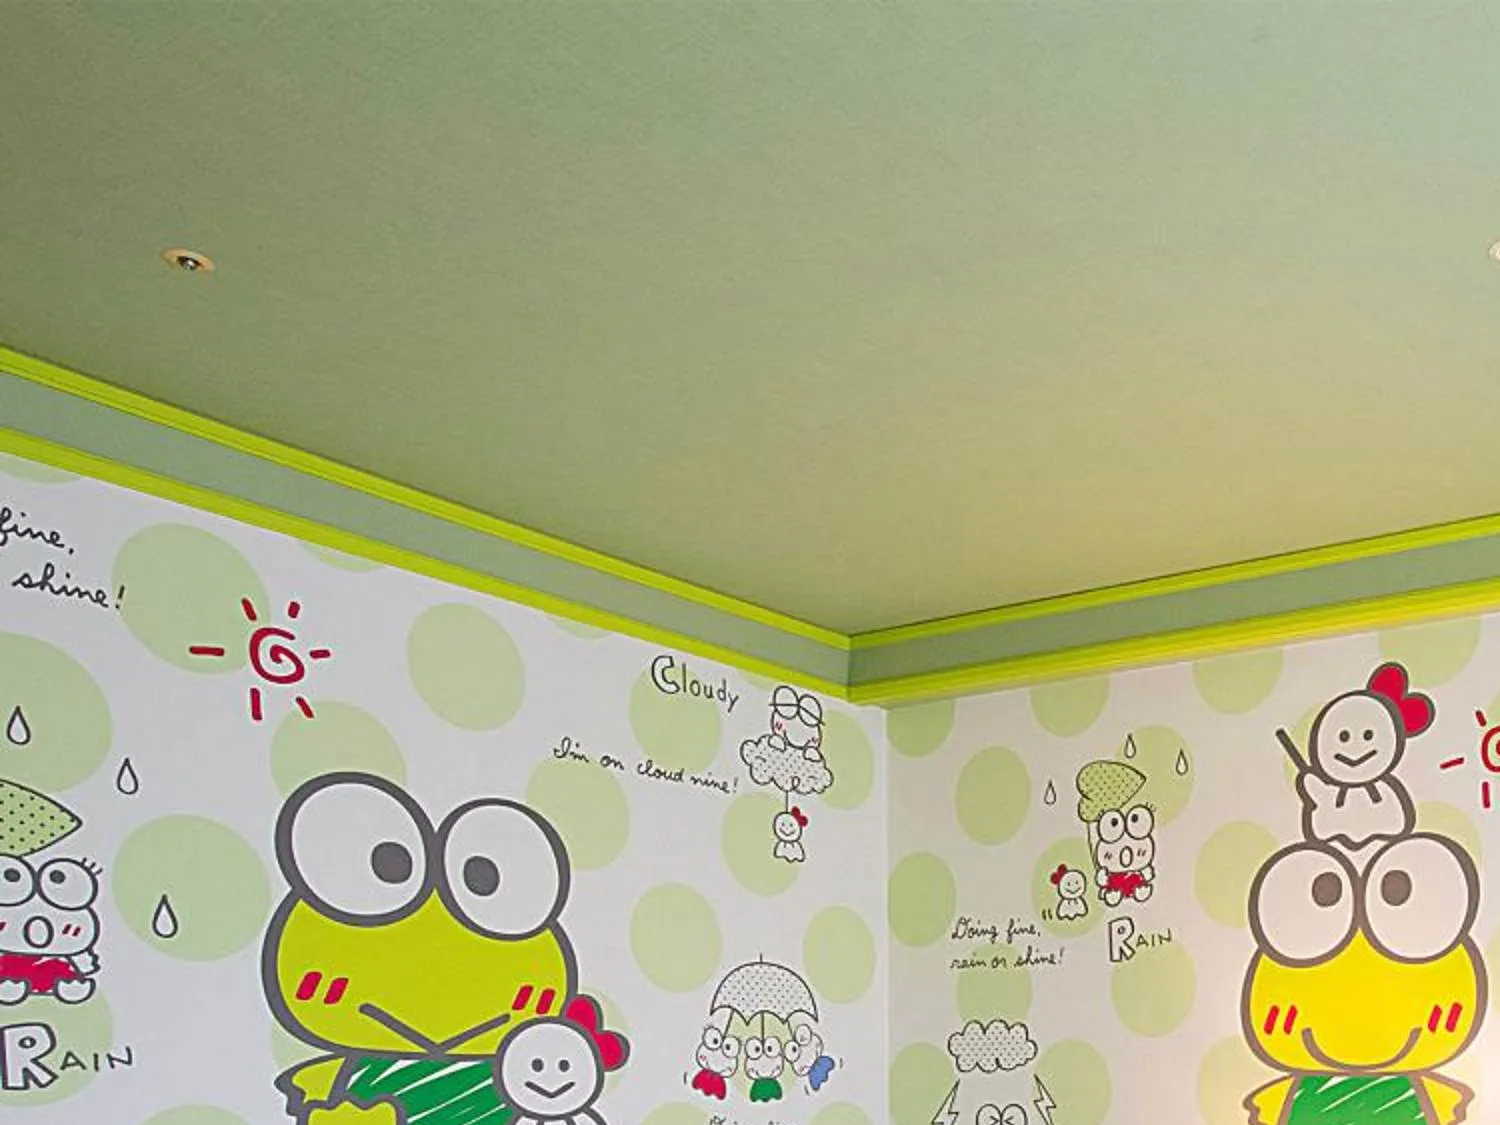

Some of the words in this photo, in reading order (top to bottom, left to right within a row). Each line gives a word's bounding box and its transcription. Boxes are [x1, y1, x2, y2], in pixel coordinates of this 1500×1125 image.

[10, 561, 126, 611] shine!
[650, 654, 740, 714] Cloudy
[599, 754, 625, 771] on
[636, 759, 685, 783] cloud
[689, 771, 739, 795] nine!
[951, 915, 1000, 945] Doing
[949, 952, 988, 970] rain
[990, 955, 1007, 969] or
[1013, 944, 1065, 968] shine!
